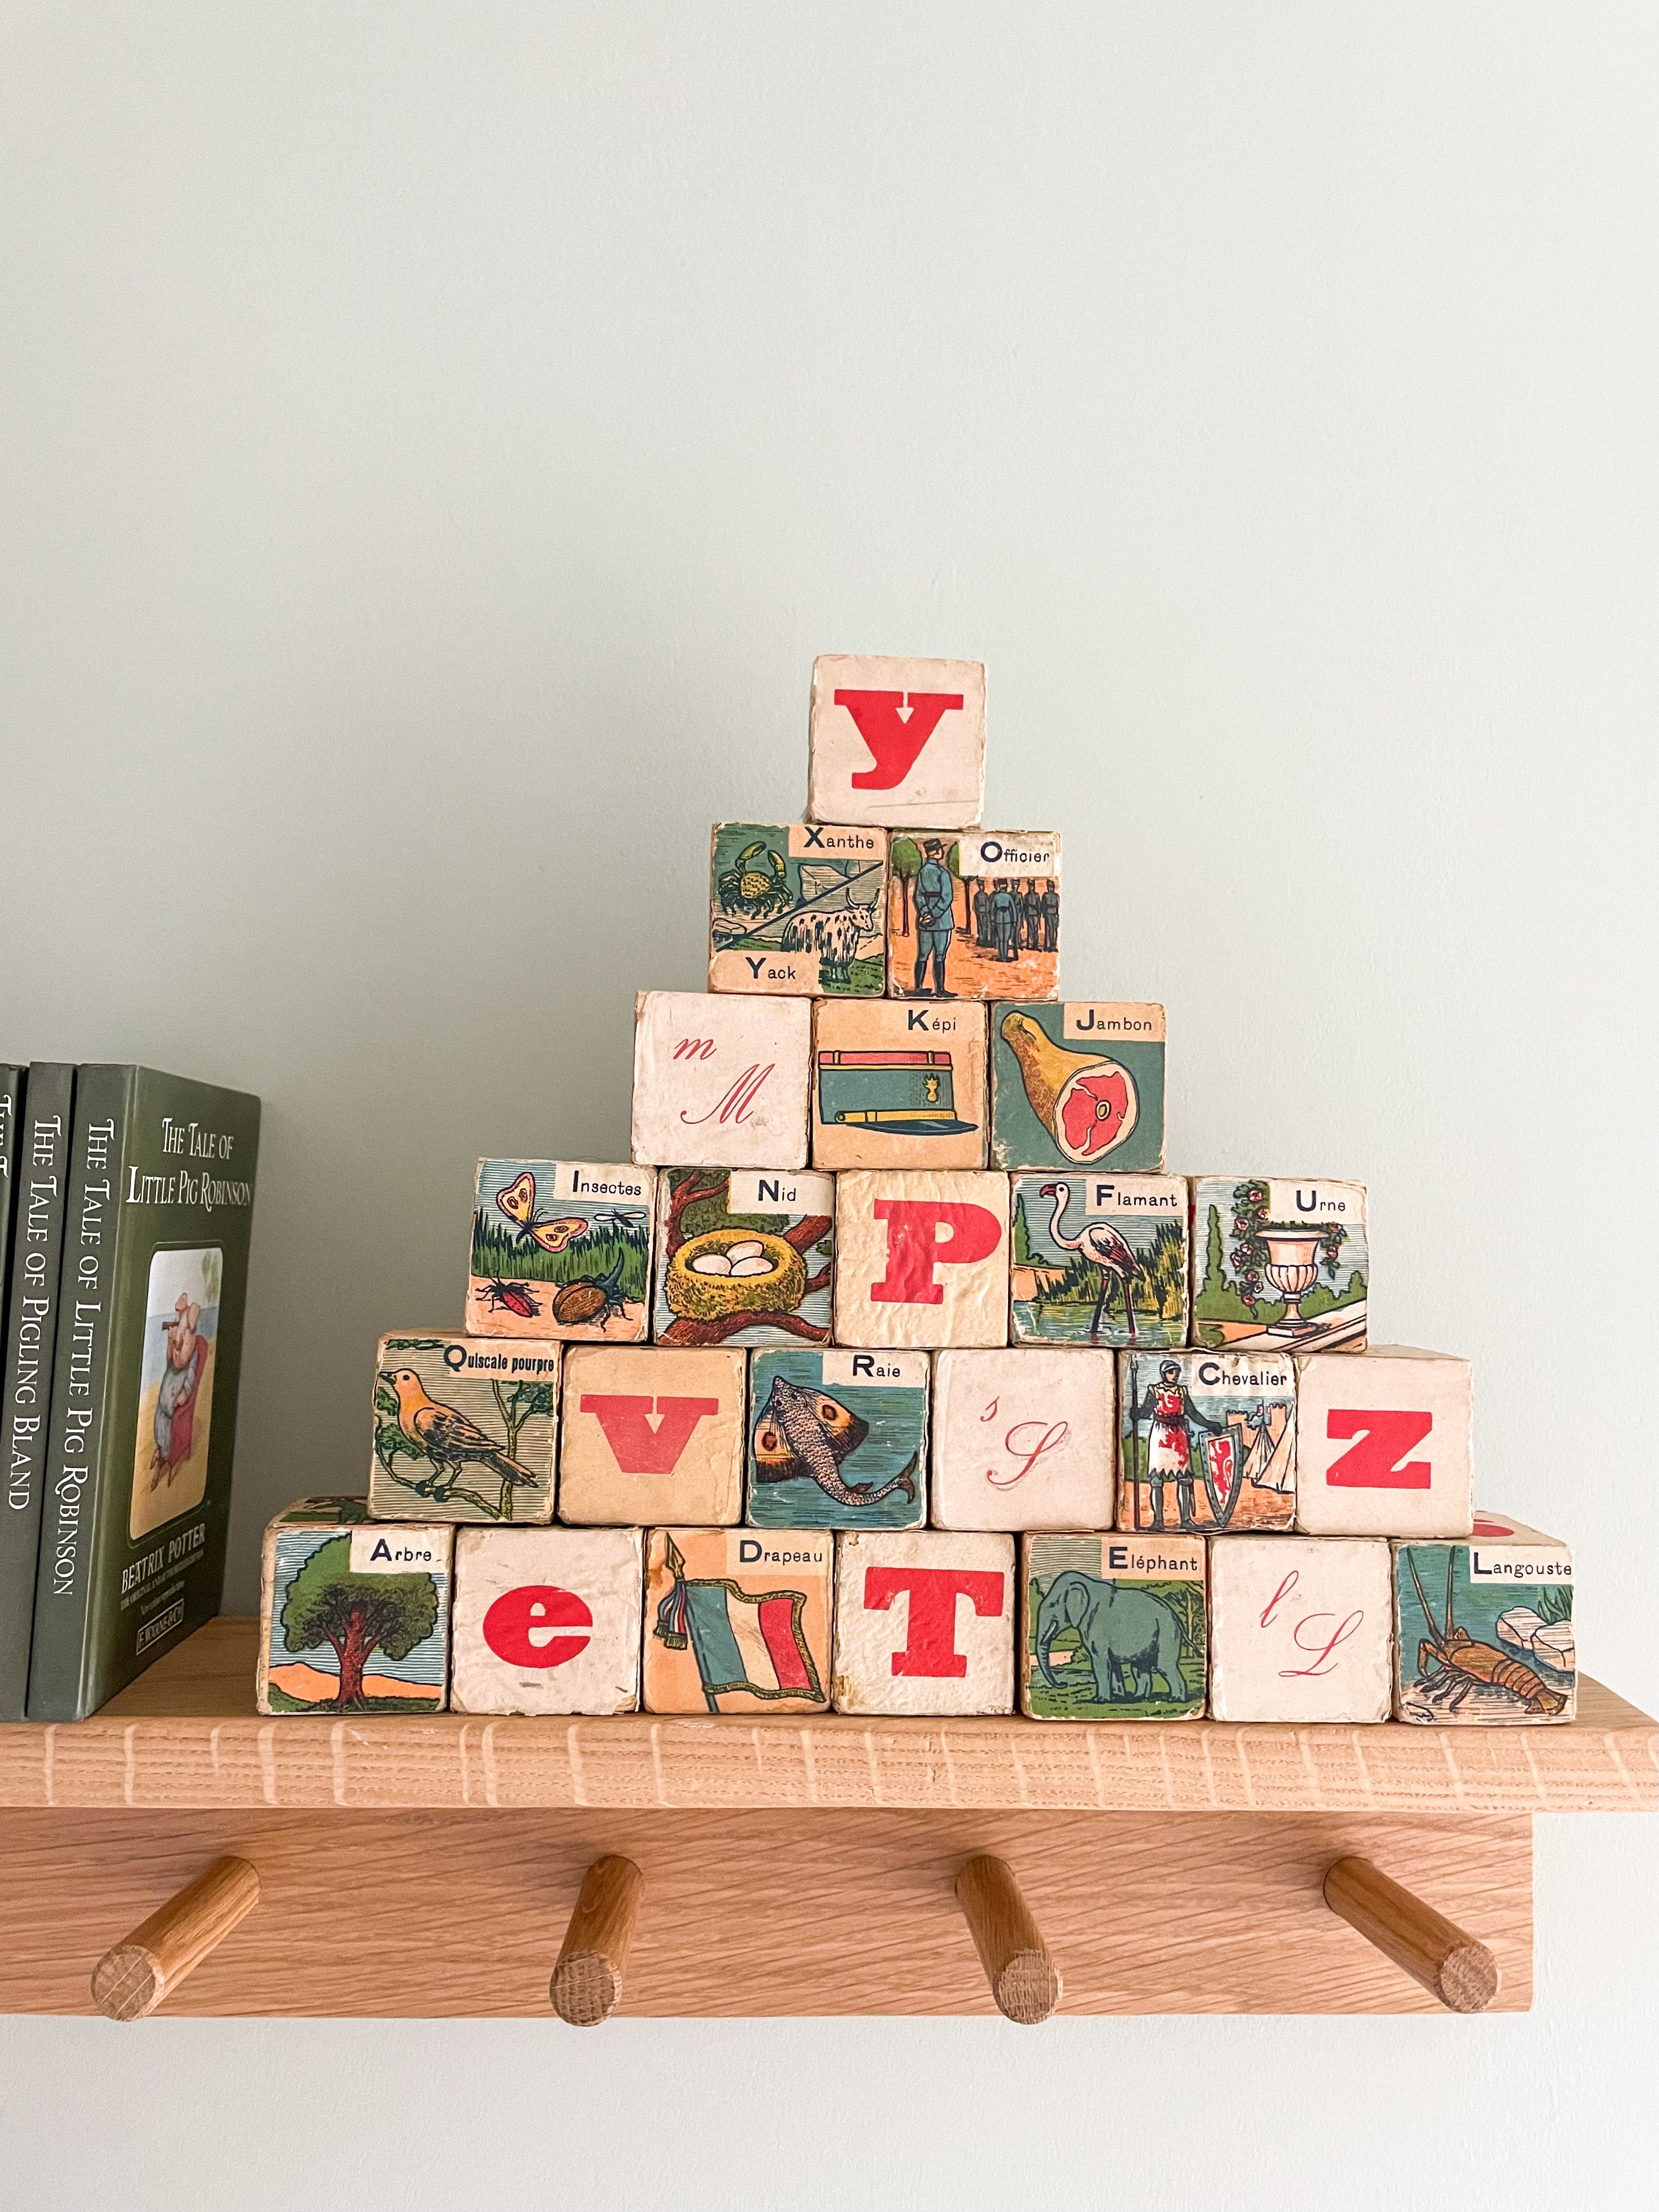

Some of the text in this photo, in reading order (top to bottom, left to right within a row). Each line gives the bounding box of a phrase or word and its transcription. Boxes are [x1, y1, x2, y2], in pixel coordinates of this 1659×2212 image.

[804, 827, 874, 849] Xanthe
[980, 841, 1049, 863] Officier
[745, 957, 796, 980] Yack
[908, 1009, 957, 1033] Képi
[1076, 1009, 1152, 1032] Jambon
[673, 1037, 717, 1061] m
[680, 1063, 775, 1125] M
[32, 1115, 61, 1166] THE
[86, 1118, 115, 1170] THE
[162, 1117, 185, 1154] THE
[188, 1123, 216, 1158] TALE
[126, 1166, 176, 1204] LITTLE
[177, 1170, 198, 1205] PIG
[573, 1170, 641, 1196] Insectes
[758, 1180, 796, 1202] Nid
[1096, 1184, 1178, 1208] Flamant
[27, 1175, 57, 1243] TALE
[80, 1179, 110, 1245] TALE
[1296, 1190, 1346, 1213] Urne
[871, 1199, 1001, 1305] P
[15, 1296, 50, 1404] PIGLING
[69, 1300, 101, 1396] LITTLE
[444, 1344, 554, 1375] Quiscale pourpre
[853, 1355, 901, 1378] Raie
[1199, 1362, 1287, 1386] Chevalier
[64, 1407, 93, 1453] PIG
[8, 1415, 41, 1510] BLAND
[53, 1464, 89, 1595] ROBINSON
[122, 1546, 165, 1594] BEATRIX
[168, 1523, 205, 1563] POTTER
[370, 1539, 432, 1562] Arbre
[739, 1539, 823, 1566] Drapeau
[1109, 1546, 1198, 1572] Eléphant
[1474, 1552, 1572, 1578] Langouste
[483, 1585, 593, 1668] e
[864, 1566, 1004, 1678] T
[1278, 1610, 1364, 1677] L
